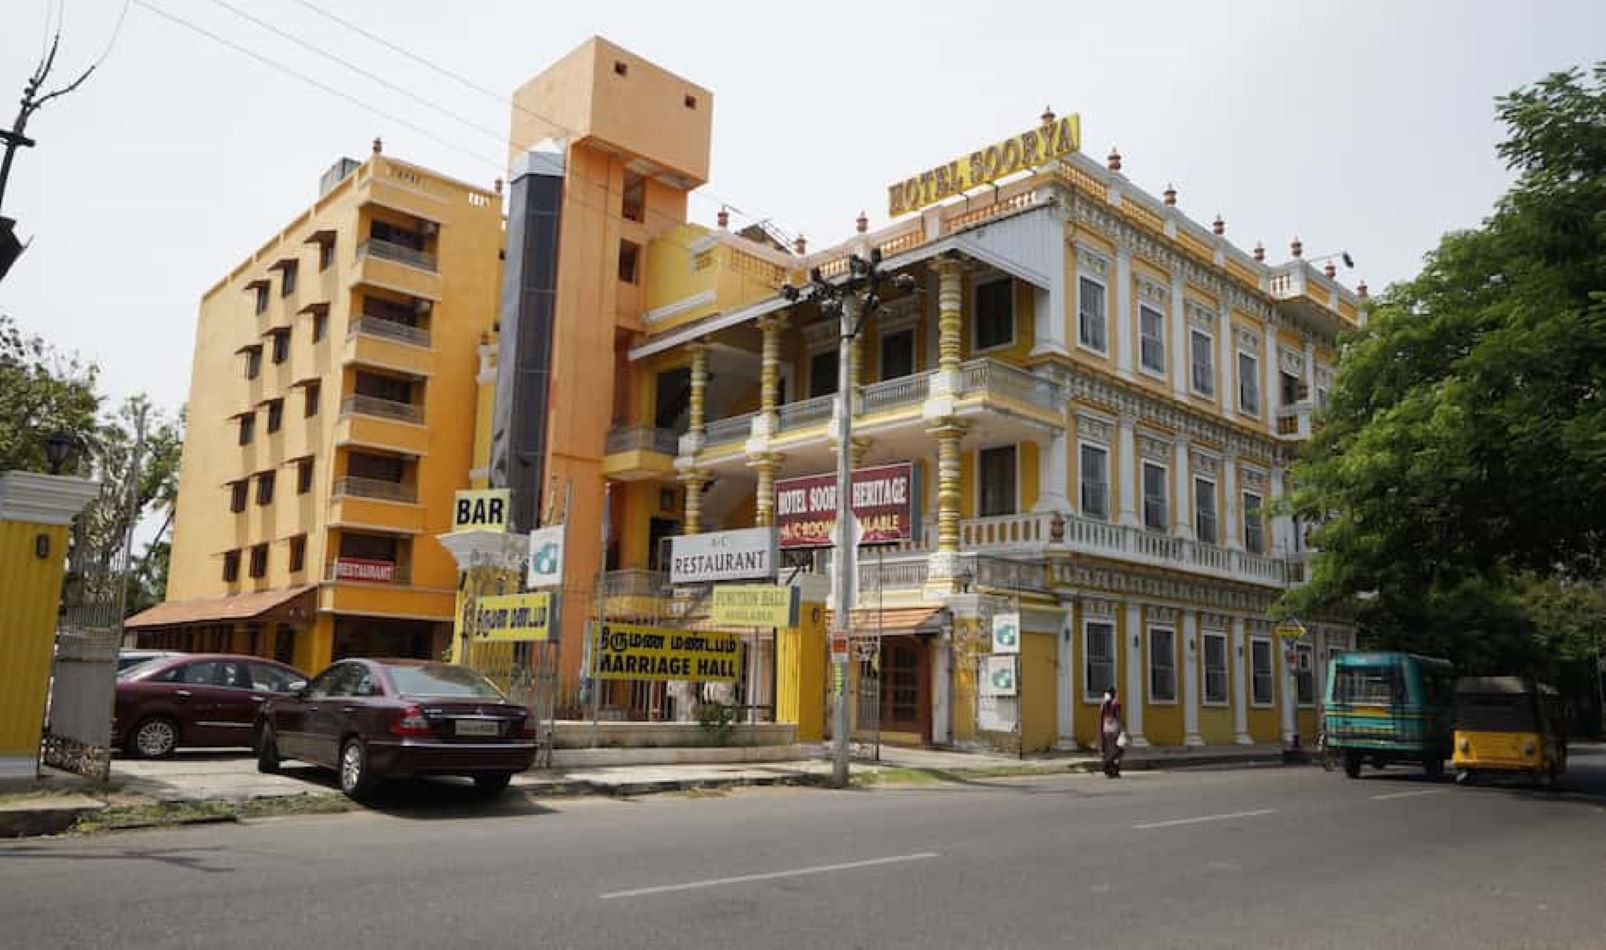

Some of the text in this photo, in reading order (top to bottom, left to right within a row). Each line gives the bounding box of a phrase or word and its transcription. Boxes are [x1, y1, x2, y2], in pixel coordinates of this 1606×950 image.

[889, 117, 1074, 214] HOTEL SOORYA
[778, 477, 907, 515] HOTEL SOOR HERITAGE
[456, 497, 504, 525] BAR
[335, 562, 392, 581] RESTAURANT
[675, 550, 766, 577] RESTAURANT
[671, 631, 736, 653] மண்டபம்
[594, 653, 736, 677] MARRIAGE HALL
